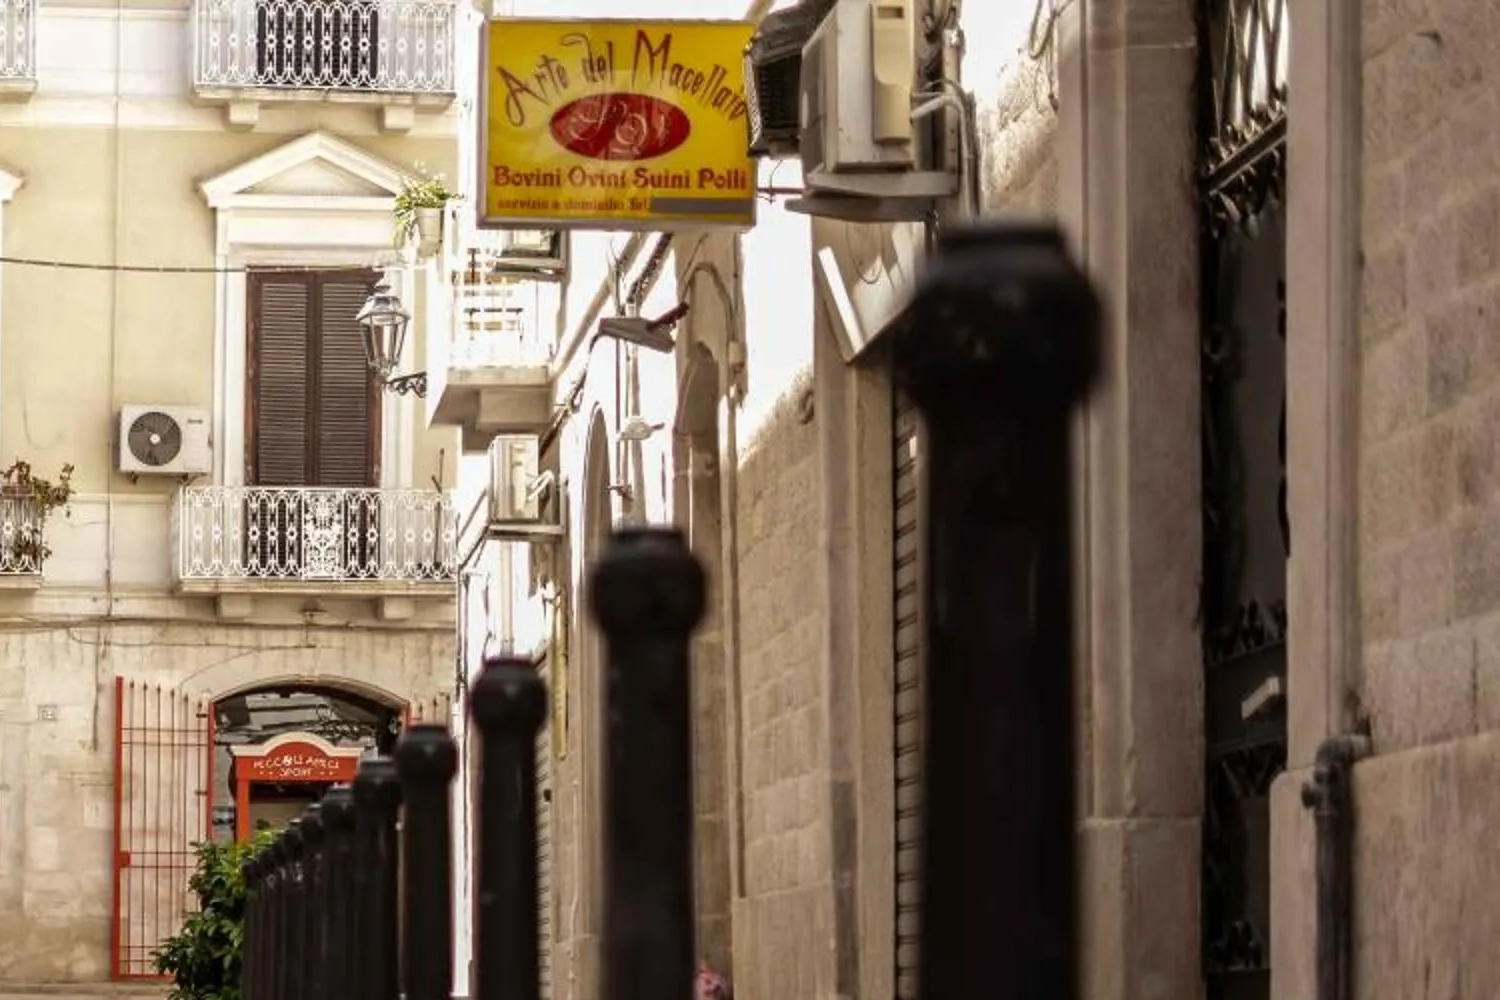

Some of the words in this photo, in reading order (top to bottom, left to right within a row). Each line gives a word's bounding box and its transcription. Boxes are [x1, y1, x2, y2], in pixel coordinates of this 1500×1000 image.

[496, 53, 569, 127] Arte
[561, 32, 613, 85] del
[493, 166, 562, 188] Bovini
[567, 166, 627, 189] Ovini
[632, 167, 691, 190] Suini
[697, 168, 747, 191] Polli
